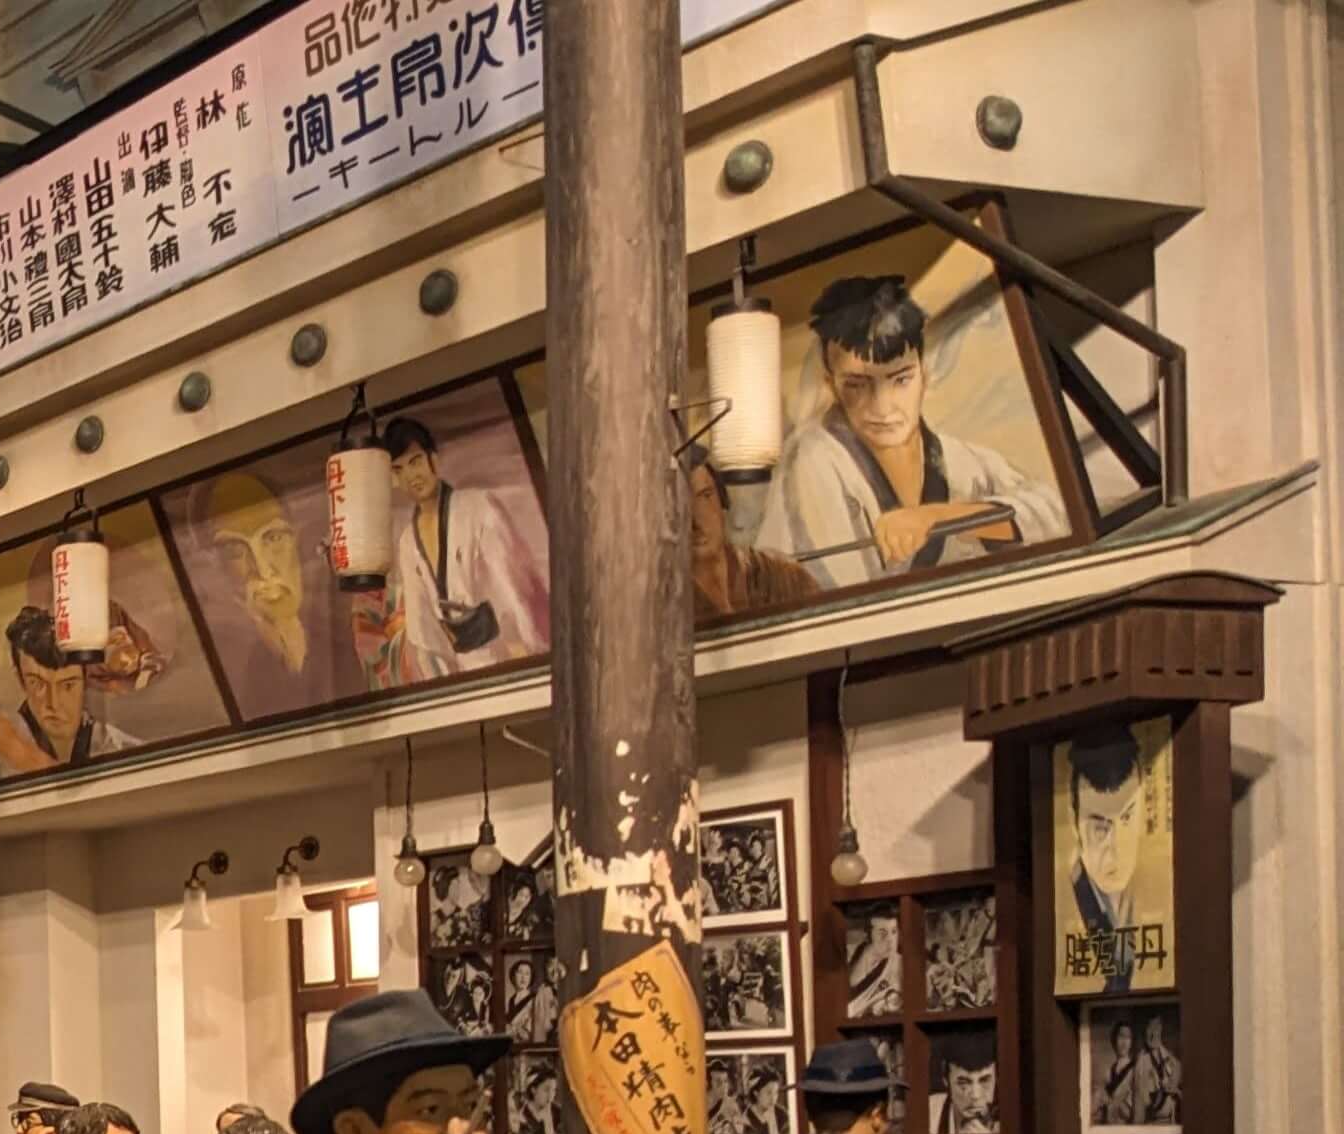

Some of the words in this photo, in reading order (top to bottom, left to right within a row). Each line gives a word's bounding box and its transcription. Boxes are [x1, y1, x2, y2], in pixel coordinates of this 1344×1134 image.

[231, 63, 253, 131] 原作
[83, 157, 125, 301] 山田五十鈴
[139, 121, 180, 273] 伊藤大輔
